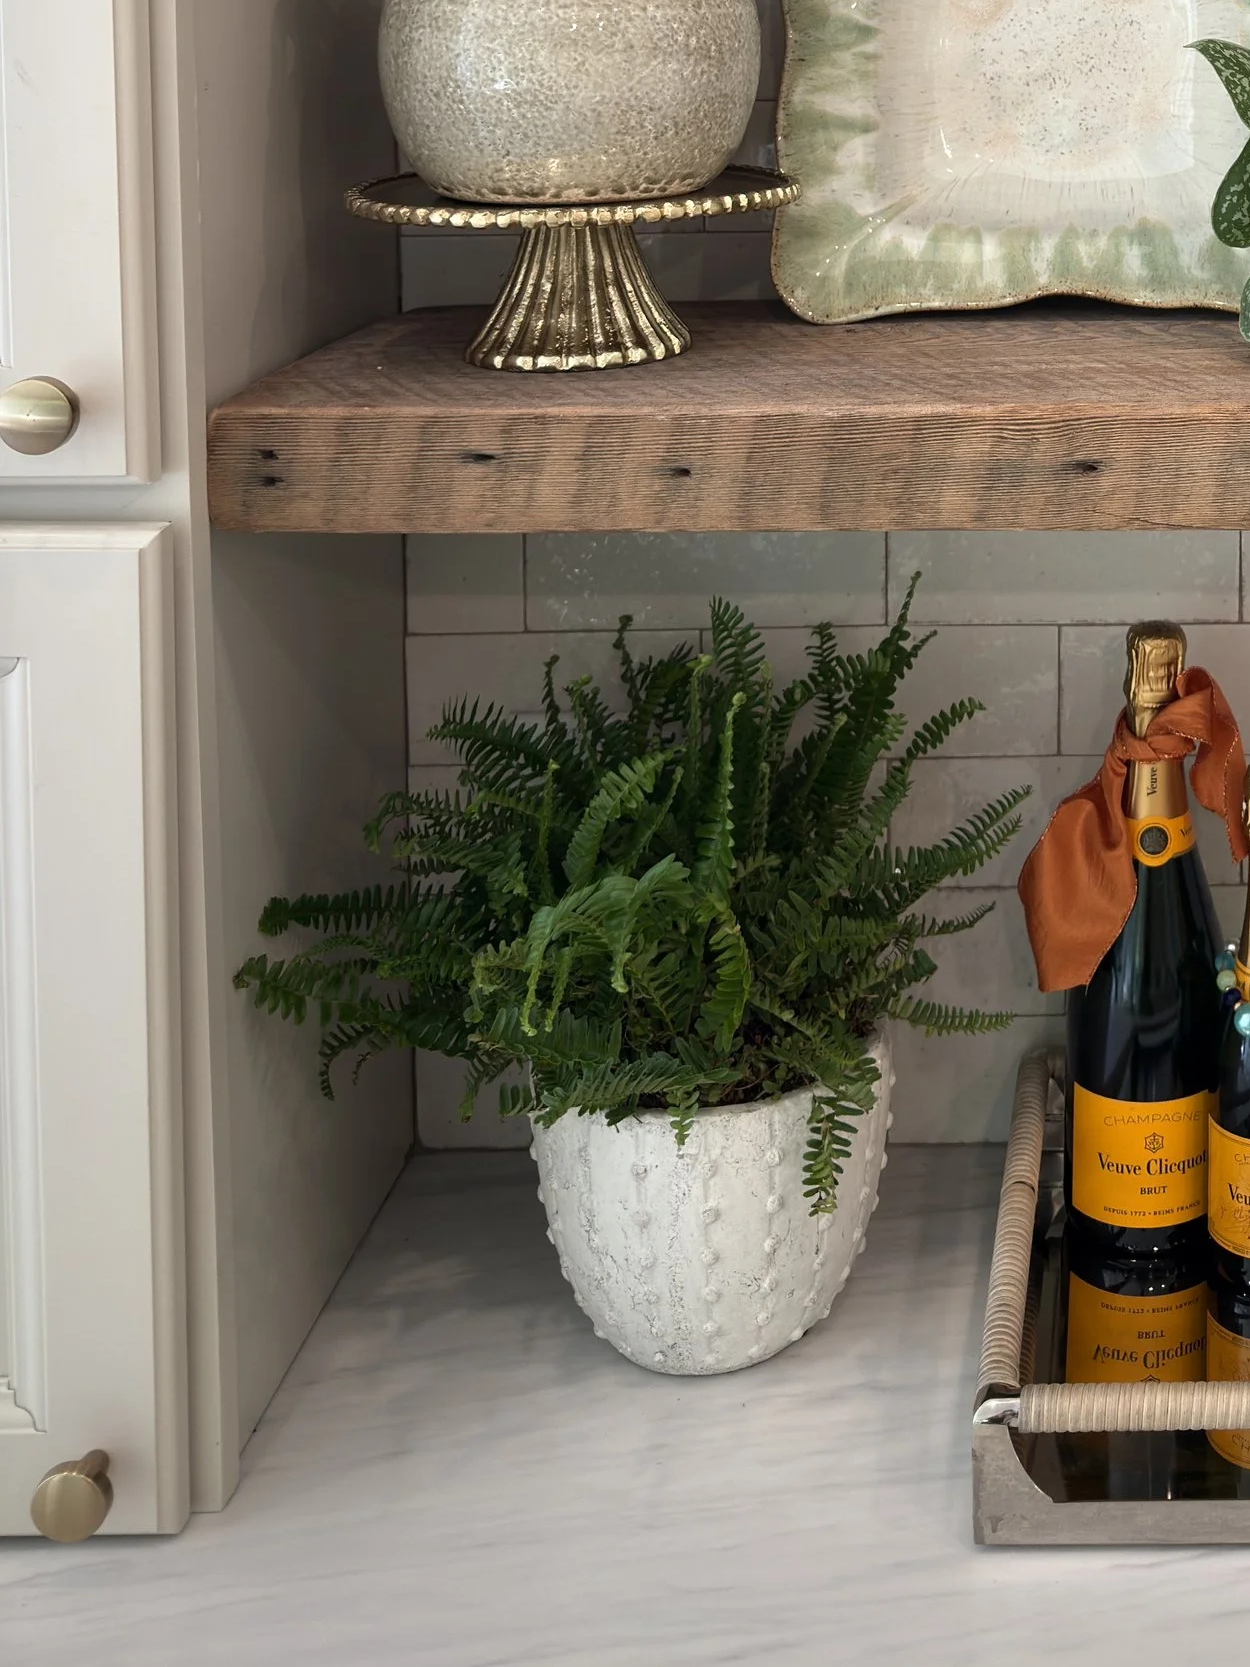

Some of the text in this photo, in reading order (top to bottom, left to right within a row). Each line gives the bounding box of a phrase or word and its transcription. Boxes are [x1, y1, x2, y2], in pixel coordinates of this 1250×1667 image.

[1146, 766, 1158, 797] Veuve
[1103, 1111, 1202, 1127] CHAMPAGNE
[1097, 1149, 1207, 1176] Veuve Clicquot
[1139, 1185, 1168, 1195] BRUT
[1103, 1205, 1128, 1216] DEPUIS
